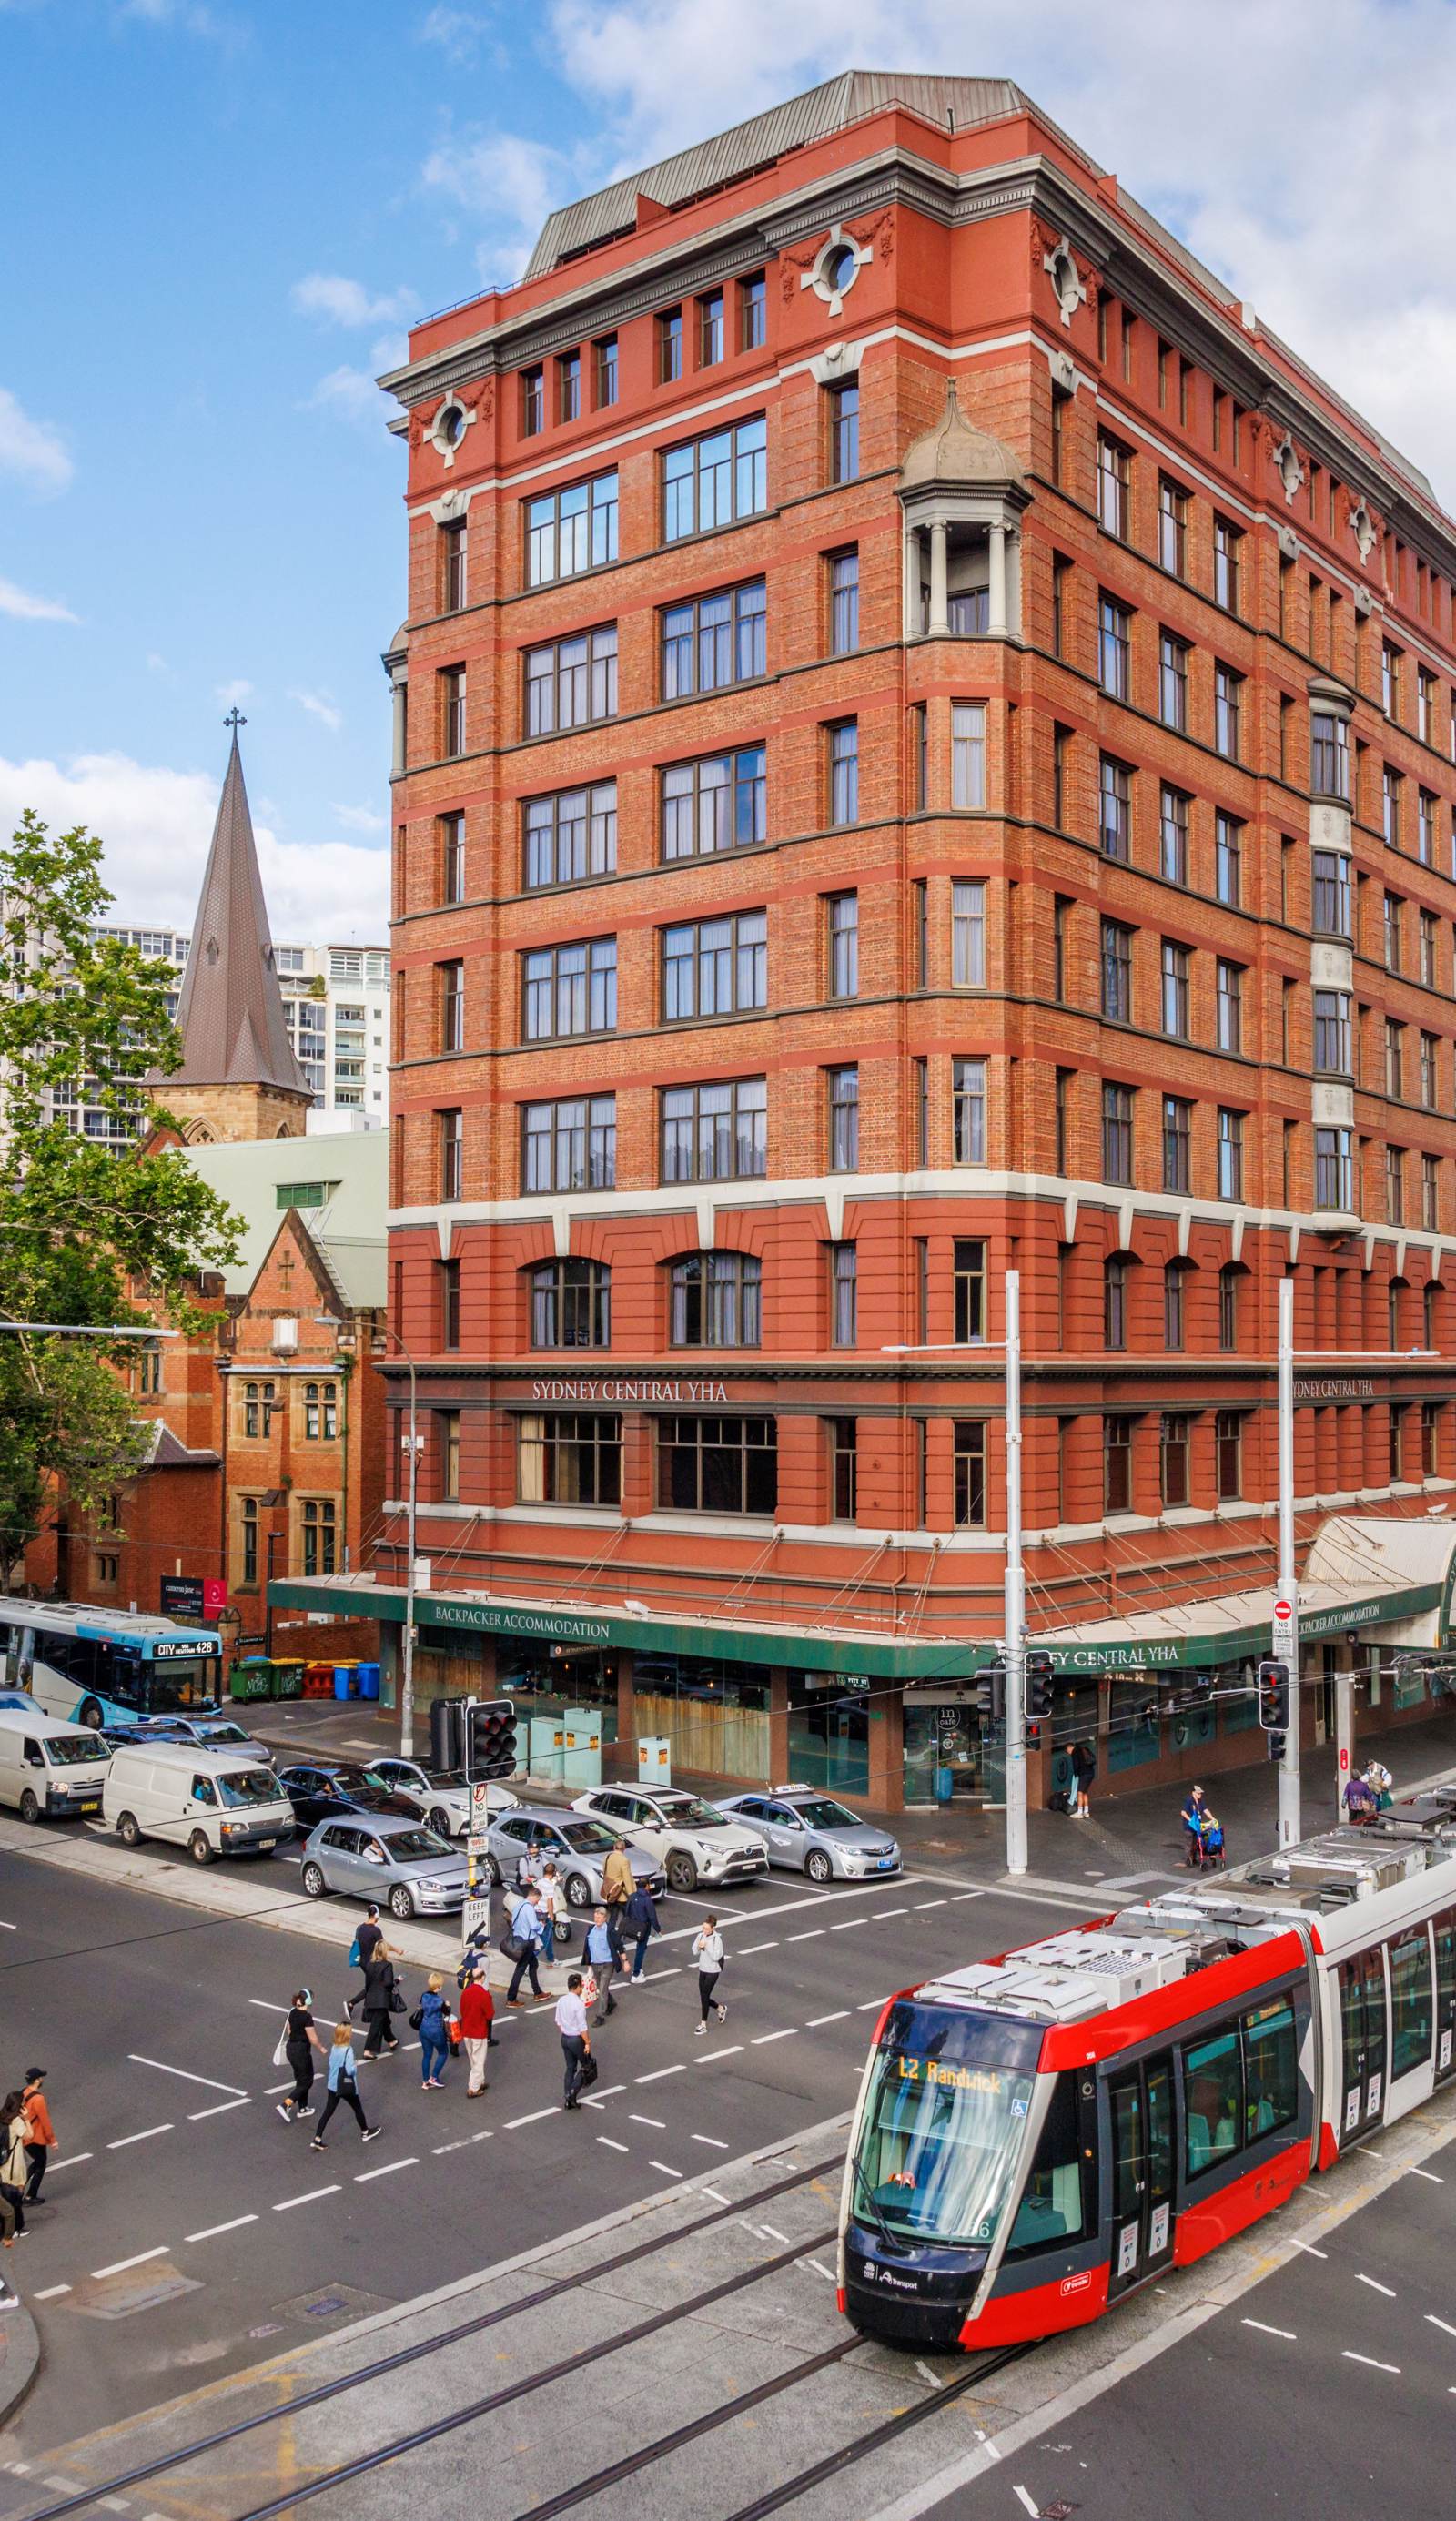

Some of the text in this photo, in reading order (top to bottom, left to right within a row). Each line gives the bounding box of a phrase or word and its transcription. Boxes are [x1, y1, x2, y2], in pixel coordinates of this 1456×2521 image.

[532, 1381, 728, 1402] SYDNEY CENTRAL YHA
[1292, 1379, 1373, 1398] YDNEY CENTRAL YHA
[435, 1606, 610, 1638] BACKPACKER ACCOMMODATION
[1327, 1604, 1380, 1629] ACCOMMODATION
[157, 1644, 175, 1656] CITY
[196, 1641, 213, 1654] 428
[1074, 1649, 1147, 1666] CENTRAL
[1148, 1645, 1178, 1662] YHA
[941, 1706, 955, 1718] in
[475, 1803, 484, 1811] NO
[468, 1900, 485, 1912] KEEP
[468, 1911, 484, 1922] LEFT
[898, 2055, 1001, 2094] L2 Randwick
[892, 2278, 918, 2290] Transport
